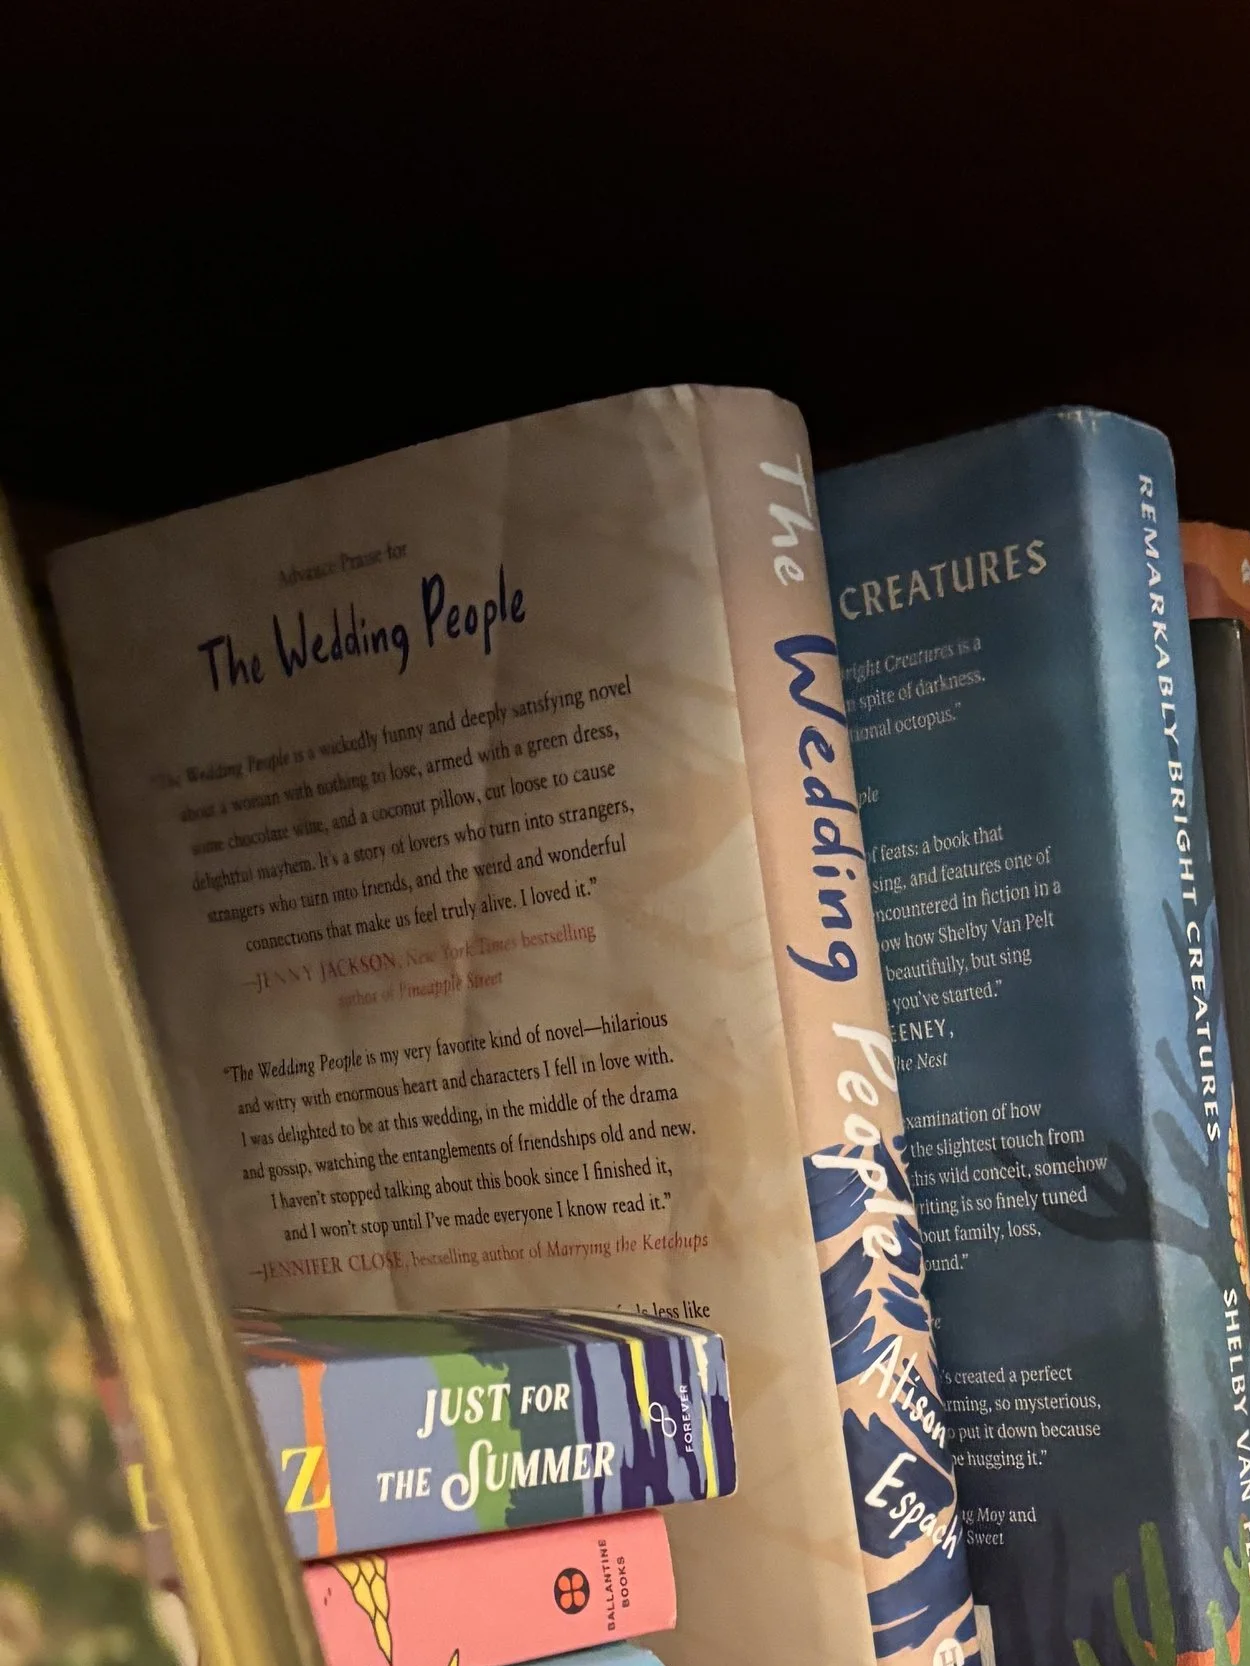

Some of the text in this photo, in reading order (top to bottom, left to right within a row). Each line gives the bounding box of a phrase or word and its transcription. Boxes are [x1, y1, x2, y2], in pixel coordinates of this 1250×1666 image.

[838, 539, 1048, 621] CREATURES
[198, 636, 265, 692] The
[273, 603, 409, 676] Wedding
[421, 563, 526, 655] People
[1138, 474, 1221, 1143] REMARKABLY BRIGHT CREATURES
[759, 455, 914, 1258] The Wedding People
[245, 928, 323, 952] connections
[325, 919, 352, 939] that
[355, 912, 390, 934] make
[395, 914, 410, 927] us
[414, 902, 437, 924] feel
[441, 897, 476, 920] truly
[480, 892, 516, 913] alive.
[520, 888, 527, 906] I
[530, 879, 571, 904] loved
[880, 909, 1053, 952] ow how Shelby Van Pelt
[885, 948, 1032, 981] beautifully, but sing
[257, 1056, 315, 1078] Wedding
[319, 1049, 362, 1072] People
[365, 1053, 376, 1065] is
[379, 1049, 398, 1066] my
[403, 1045, 431, 1062] very
[435, 1037, 486, 1056] favorite
[489, 1025, 521, 1048] kind
[526, 1023, 541, 1043] of
[545, 1011, 667, 1041] novel—hilarious
[237, 1045, 673, 1114] and witty with enormous heart and characters I fell in love with.
[240, 1085, 678, 1147] I was delighted to be at this wedding, in the middle of the drama
[905, 1102, 1041, 1129] xamination of how
[910, 1127, 1084, 1158] the slightest touch from
[242, 1161, 264, 1179] and
[315, 1151, 376, 1171] watching
[377, 1147, 398, 1165] the
[402, 1140, 496, 1164] entanglements
[500, 1133, 513, 1153] of
[518, 1127, 596, 1151] friendships
[600, 1122, 624, 1143] old
[628, 1119, 656, 1140] and
[660, 1122, 695, 1137] new.
[938, 1165, 969, 1184] wild
[972, 1161, 1031, 1181] conceit,
[1034, 1155, 1107, 1176] somehow
[270, 1193, 276, 1209] I
[329, 1181, 381, 1206] stopped
[384, 1179, 431, 1200] talking
[434, 1175, 473, 1194] about
[476, 1171, 501, 1189] this
[503, 1167, 540, 1187] book
[544, 1166, 578, 1184] since
[582, 1163, 589, 1180] I
[593, 1157, 651, 1179] finished
[656, 1160, 672, 1176] it,
[919, 1185, 1087, 1216] riting is so finely tuned
[284, 1222, 308, 1241] and
[310, 1222, 316, 1238] I
[360, 1221, 388, 1237] stop
[390, 1211, 422, 1231] until
[454, 1206, 489, 1226] made
[493, 1206, 553, 1225] everyone
[556, 1200, 562, 1217] I
[566, 1198, 606, 1217] know
[612, 1192, 644, 1213] read
[682, 1300, 711, 1319] like
[1223, 1288, 1249, 1417] SHELBY
[416, 1381, 571, 1440] JUST FOR
[679, 1384, 695, 1454] FOREVER
[859, 1334, 947, 1448] Alison
[946, 1421, 1100, 1442] o put it down because
[280, 1445, 332, 1514] Z
[377, 1438, 616, 1512] THE SUMMER
[863, 1450, 961, 1560] Espach
[597, 1538, 616, 1632] BALLANTINE
[616, 1555, 631, 1609] BOOKS
